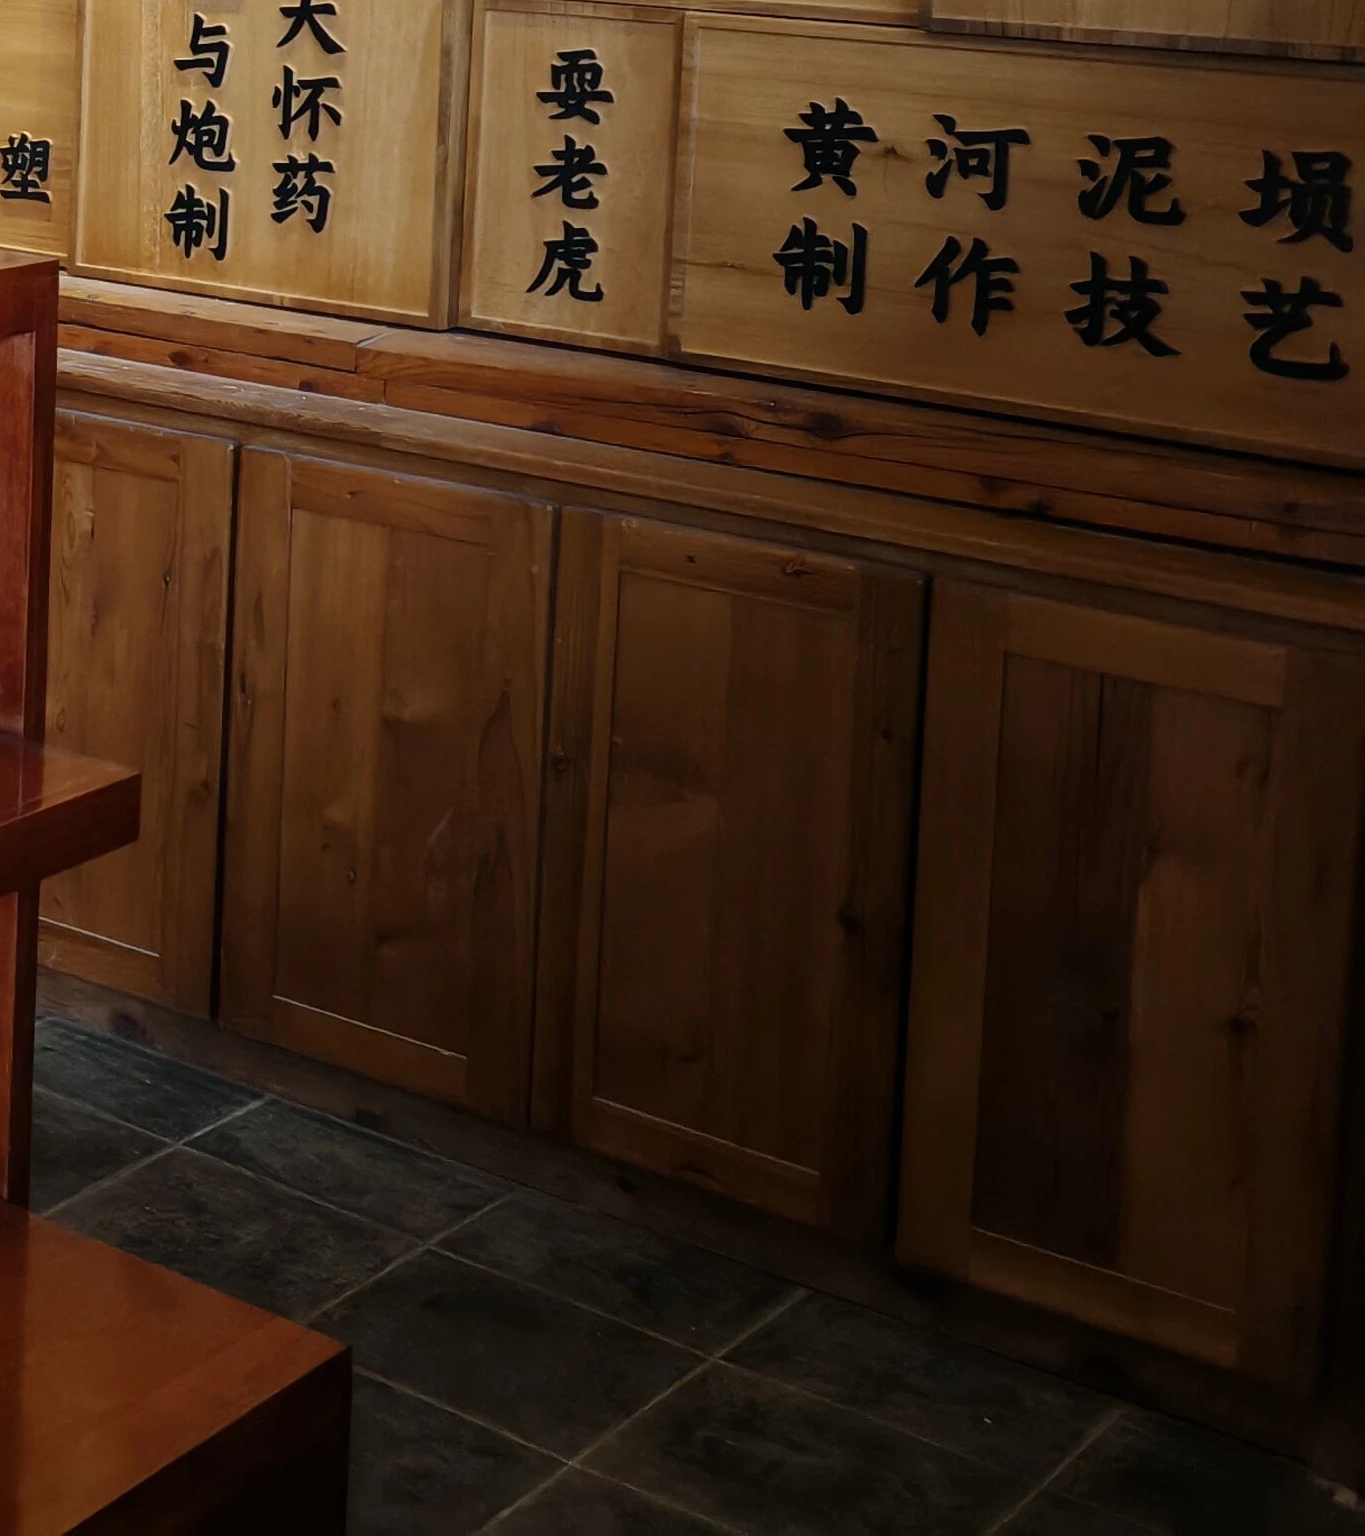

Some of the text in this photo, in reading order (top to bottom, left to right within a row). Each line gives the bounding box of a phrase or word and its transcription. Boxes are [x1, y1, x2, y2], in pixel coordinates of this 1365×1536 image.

[525, 49, 616, 304] 耍老虎
[782, 97, 1354, 253] 黄河泥埙
[772, 216, 1349, 382] 制作技艺
